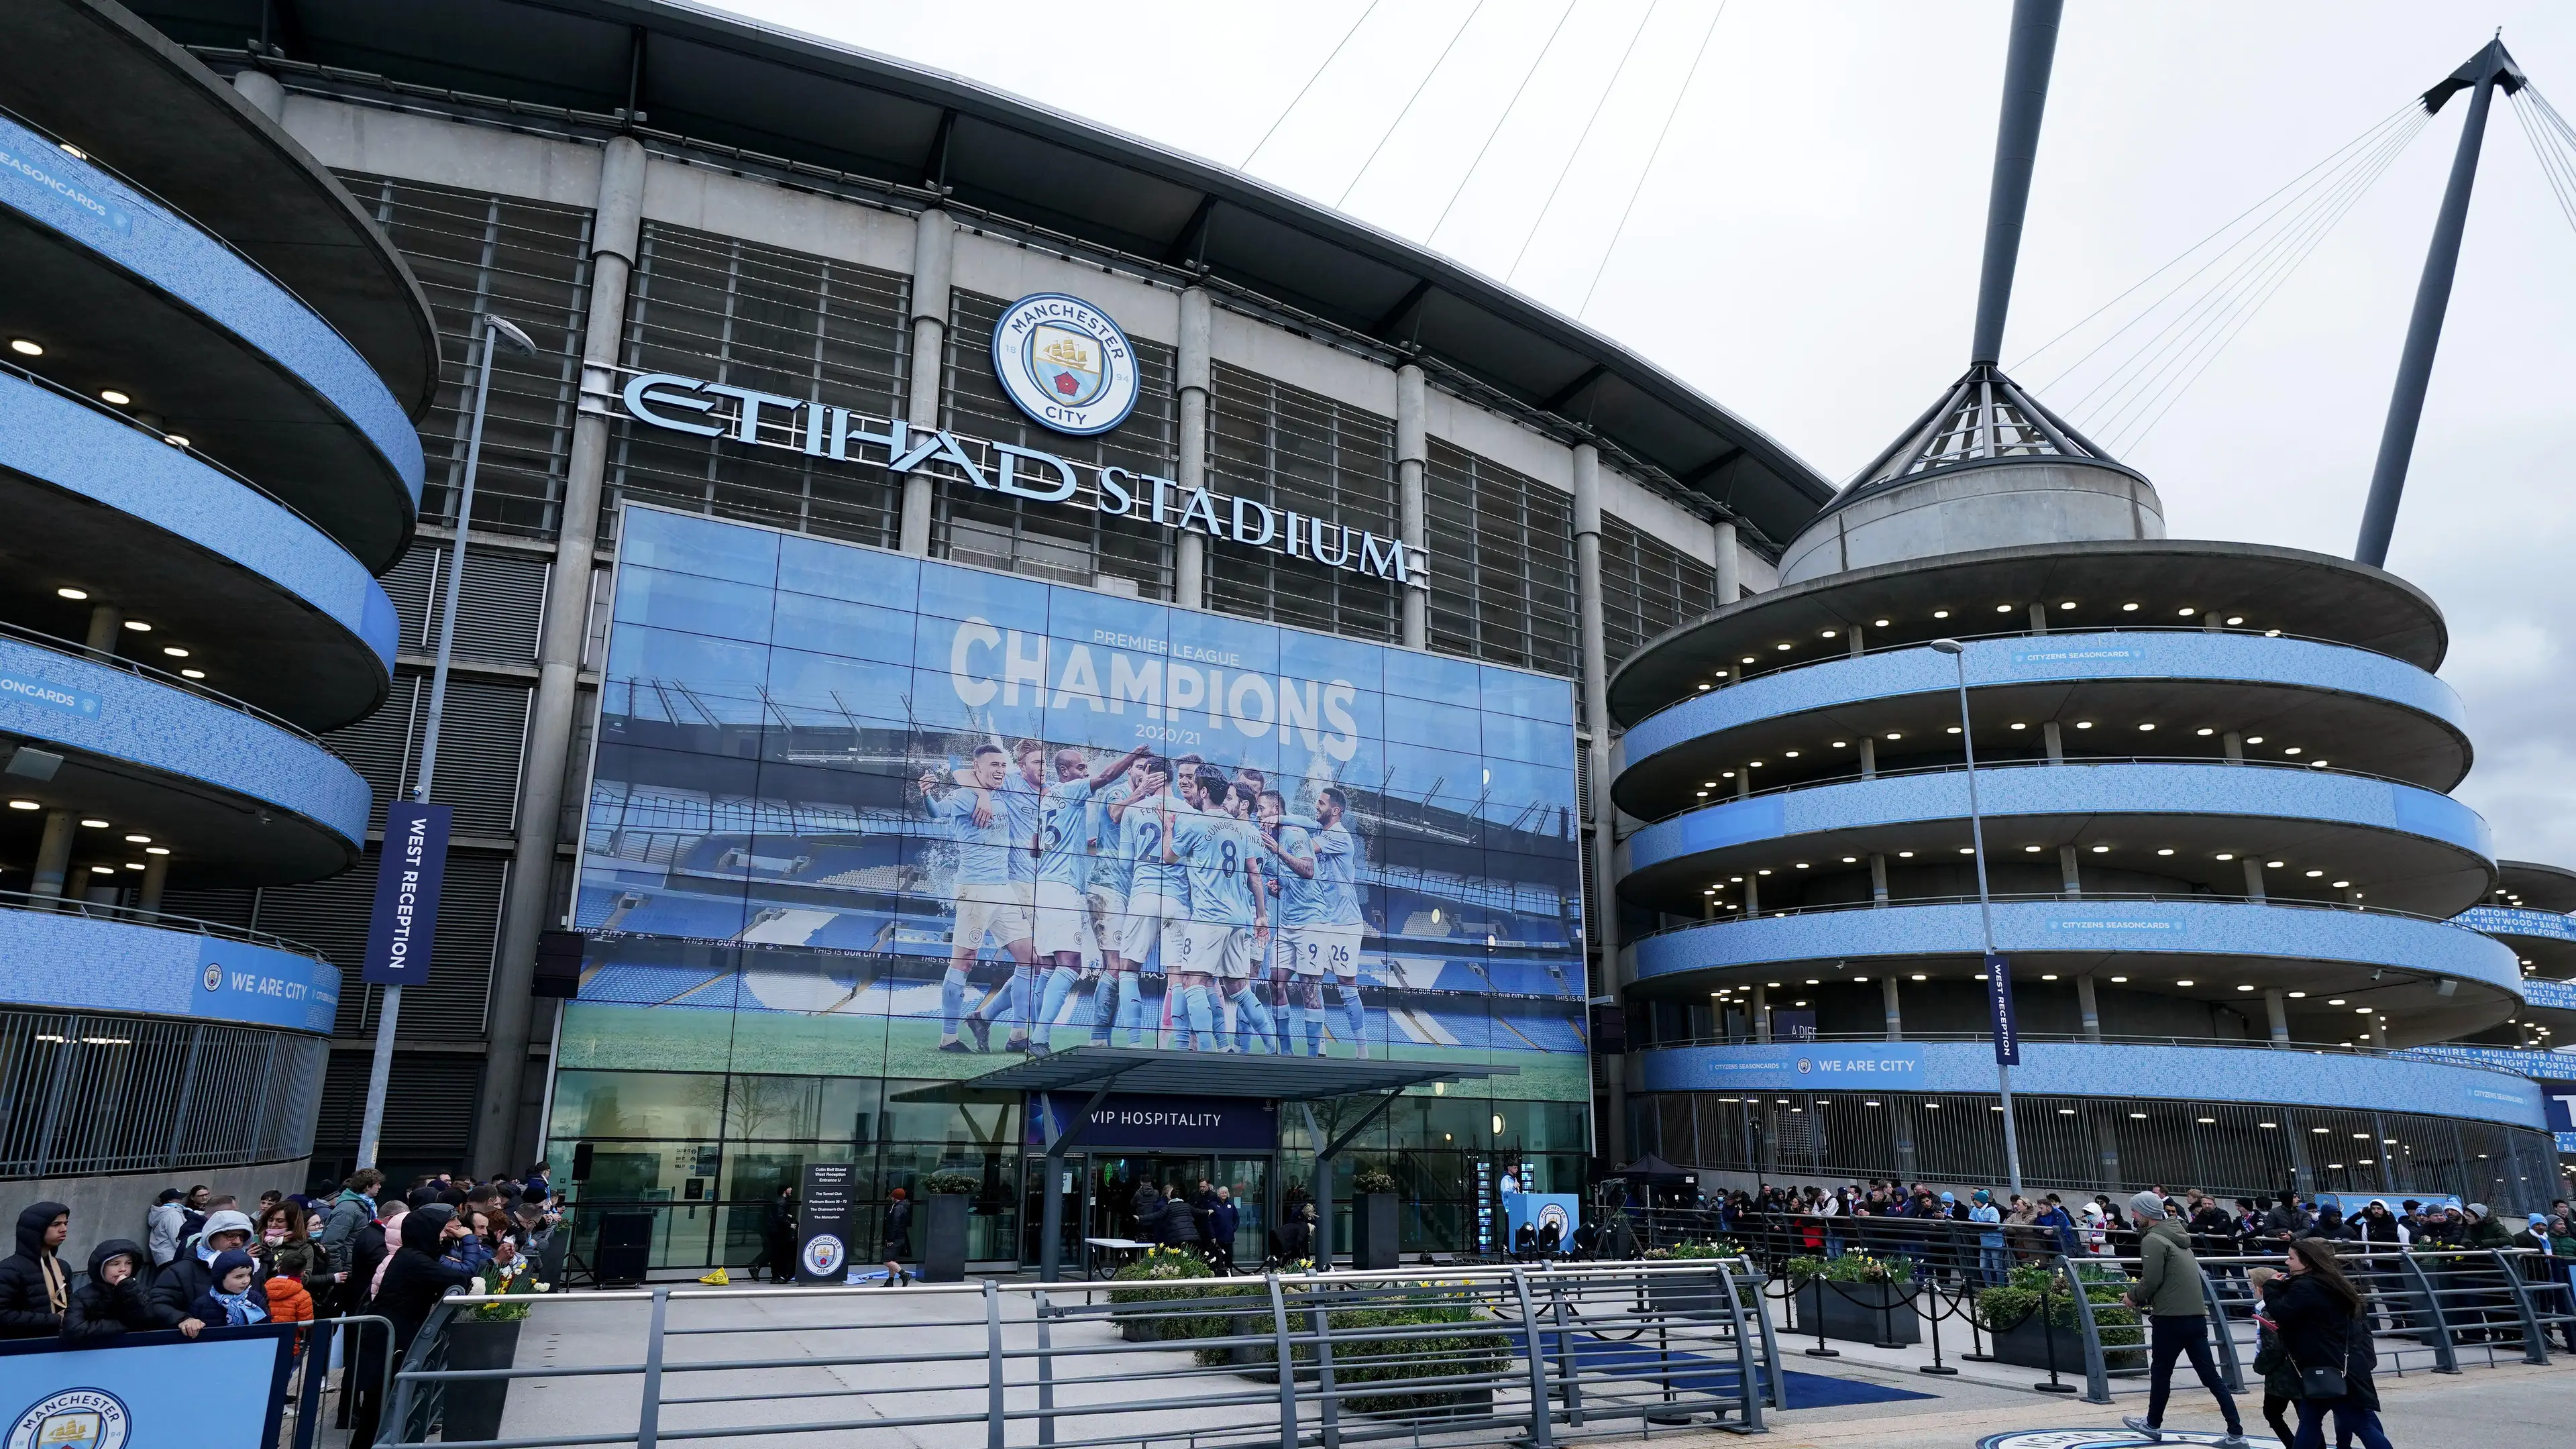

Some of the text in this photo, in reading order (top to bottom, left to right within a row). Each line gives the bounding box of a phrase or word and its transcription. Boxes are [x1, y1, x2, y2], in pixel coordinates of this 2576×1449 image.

[1011, 304, 1124, 360] MANCHESTER
[1006, 345, 1016, 354] 18
[1116, 374, 1130, 383] 94
[1045, 406, 1087, 425] CITY
[623, 374, 1407, 584] ETIHAD STADIUM
[1093, 629, 1240, 667] PREMIER LEAGUE
[951, 616, 1358, 762] CHAMPIONS
[1135, 724, 1201, 745] 2020/21
[405, 818, 427, 866] WEST
[1221, 840, 1236, 878] 8
[389, 871, 419, 968] RECEPTION
[2463, 908, 2508, 917] GORTON
[2518, 911, 2561, 922] ADELAIDE
[2481, 916, 2532, 927] HEYWOOD
[2539, 921, 2564, 930] BASEL
[601, 929, 627, 938] CITY
[2523, 927, 2561, 938] GILFORD
[682, 936, 704, 945] THIS
[716, 939, 737, 947] OUR
[1183, 937, 1191, 955] 8
[812, 947, 832, 955] THIS
[844, 949, 861, 957] OUR
[863, 951, 881, 959] CITY
[1308, 943, 1317, 960] 9
[1331, 945, 1349, 962] 26
[1994, 964, 2004, 994] WEST
[231, 971, 256, 993] WE
[257, 977, 284, 997] ARE
[286, 981, 308, 1002] CITY
[2524, 981, 2573, 992] NORTHERN
[2524, 988, 2555, 998] MALTA
[2541, 998, 2564, 1006] CLUB
[1791, 1024, 1797, 1037] A
[1998, 996, 2010, 1056] RECEPTION
[2482, 1050, 2546, 1061] MULLINGAR
[1819, 1060, 1841, 1071] WE
[1846, 1060, 1876, 1071] ARE
[1880, 1060, 1915, 1071] CITY
[2492, 1059, 2529, 1067] WIGHT
[2541, 1069, 2569, 1078] WEST
[1091, 1111, 1221, 1126] VIP HOSPITALITY
[1541, 1205, 1566, 1218] MANCHESTER
[808, 1236, 841, 1250] MANCHESTER
[23, 1395, 119, 1430] MANCHESTER
